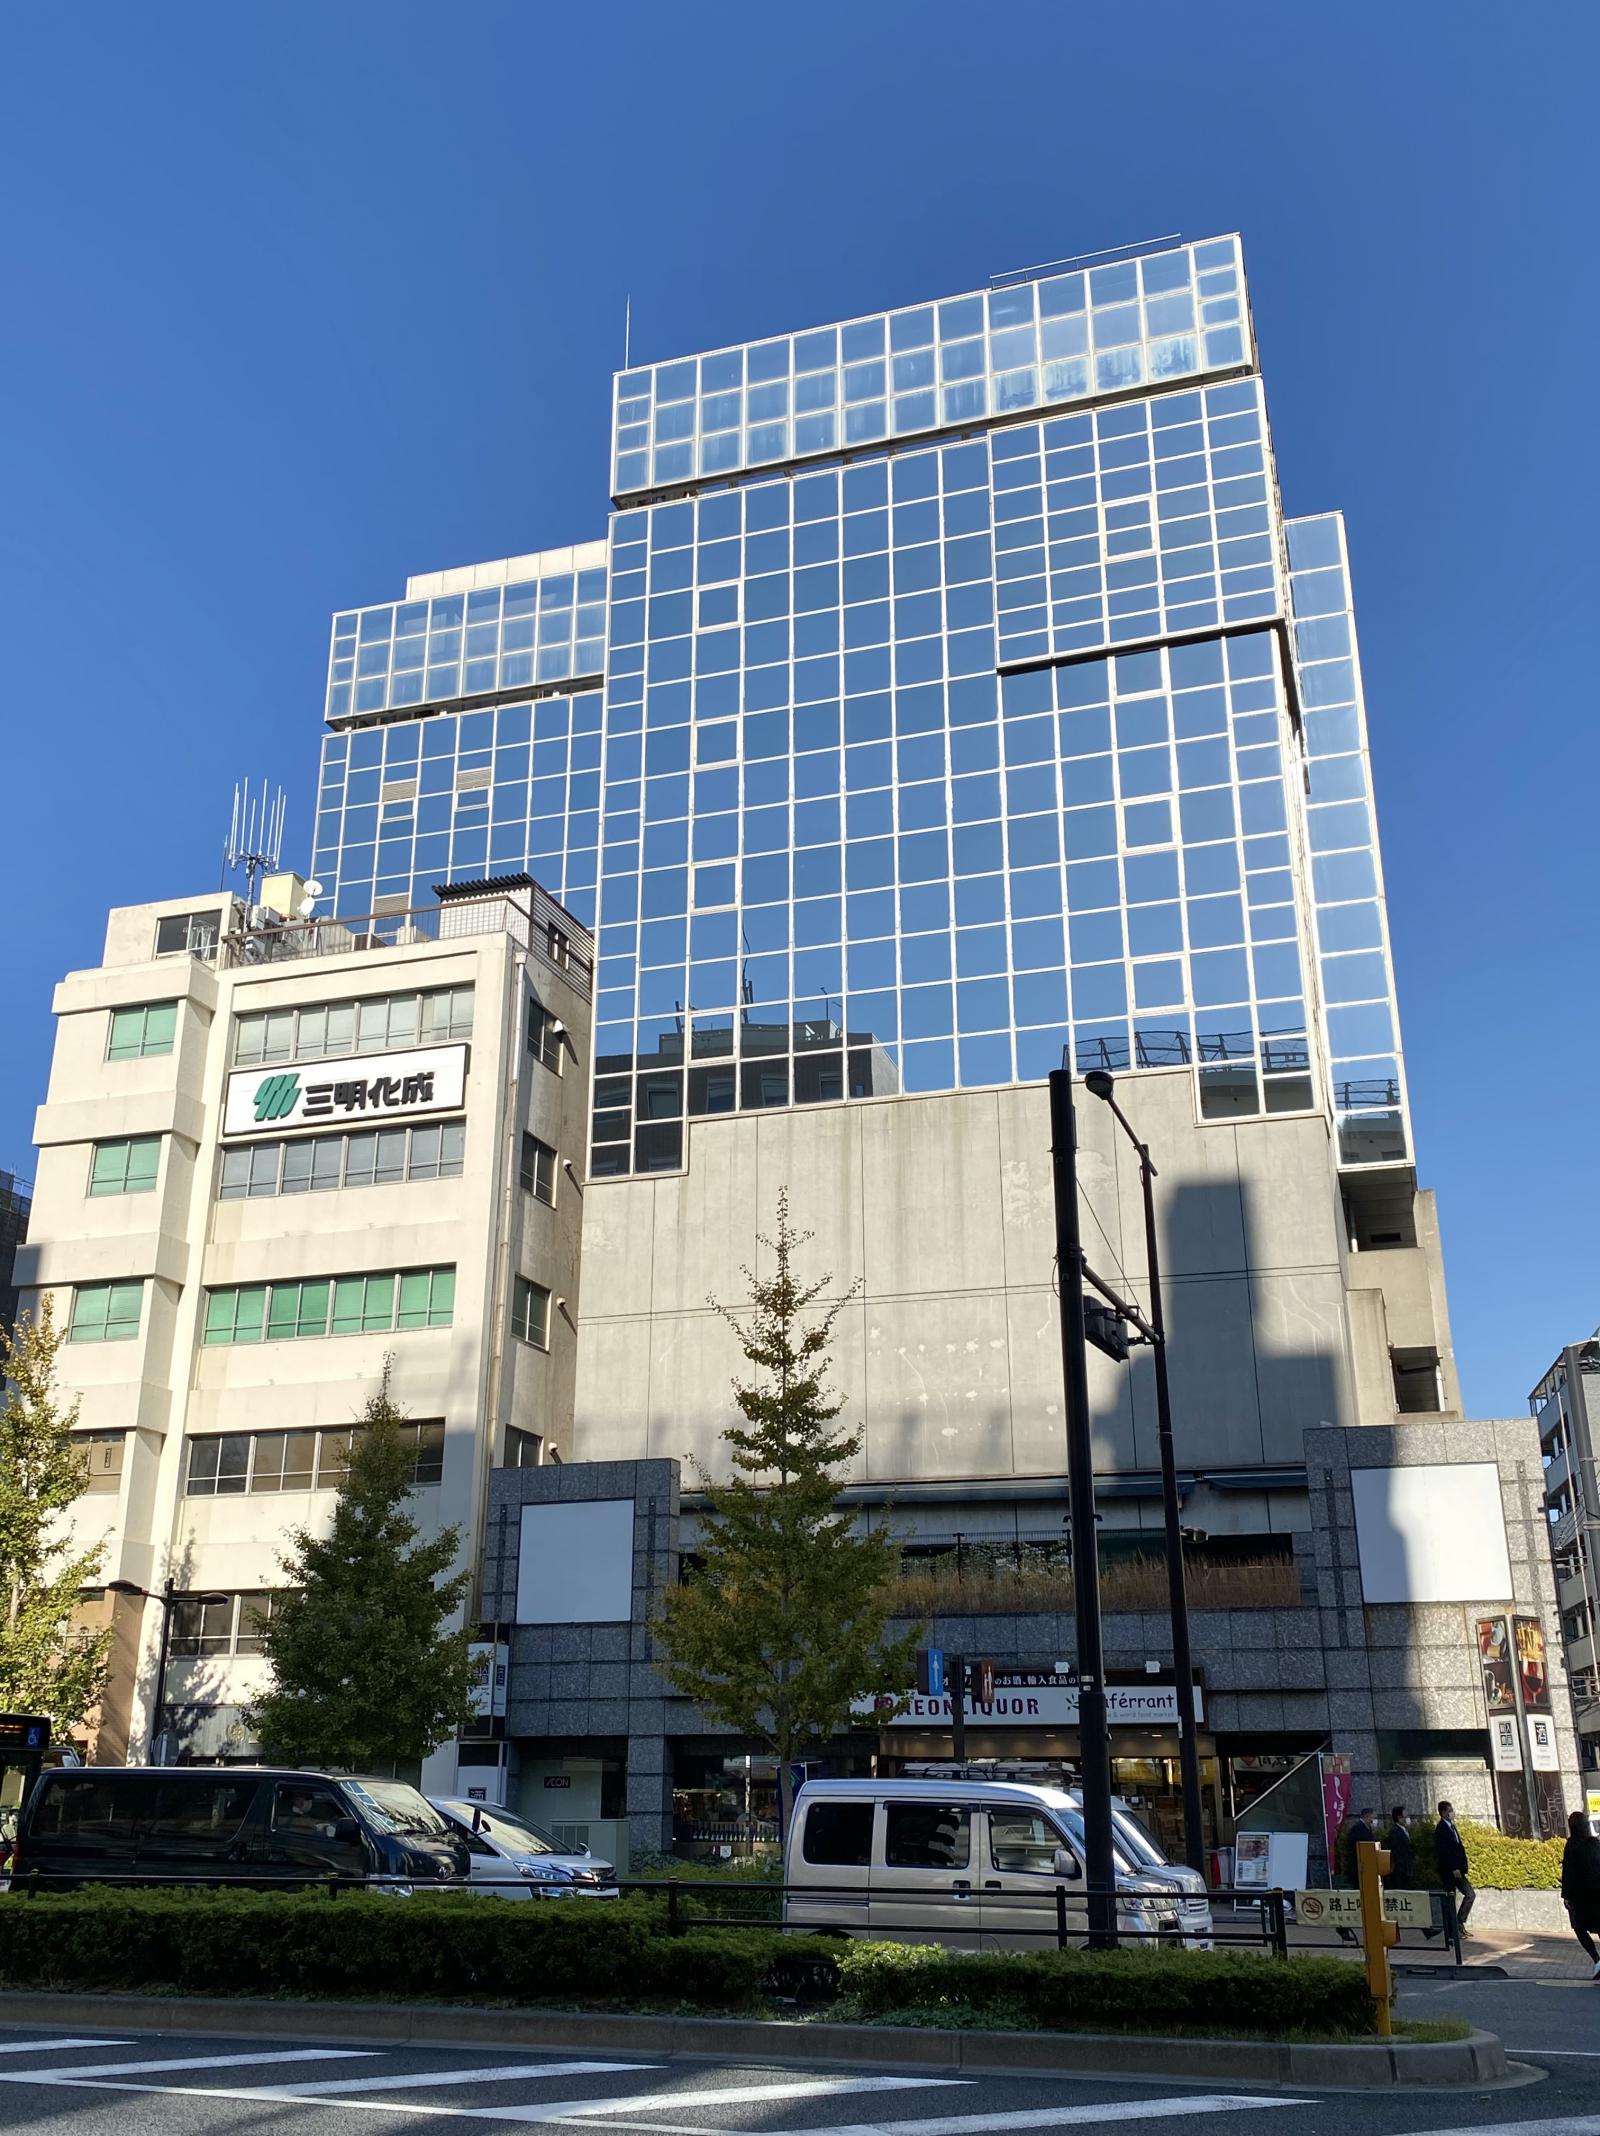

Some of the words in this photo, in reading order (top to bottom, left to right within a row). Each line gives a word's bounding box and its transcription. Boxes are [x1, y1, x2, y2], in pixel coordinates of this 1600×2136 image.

[302, 1072, 434, 1117] 三明化成
[902, 1699, 954, 1716] EON
[960, 1698, 1039, 1716] IQUOR
[1329, 1897, 1413, 1912] 路上禁止
